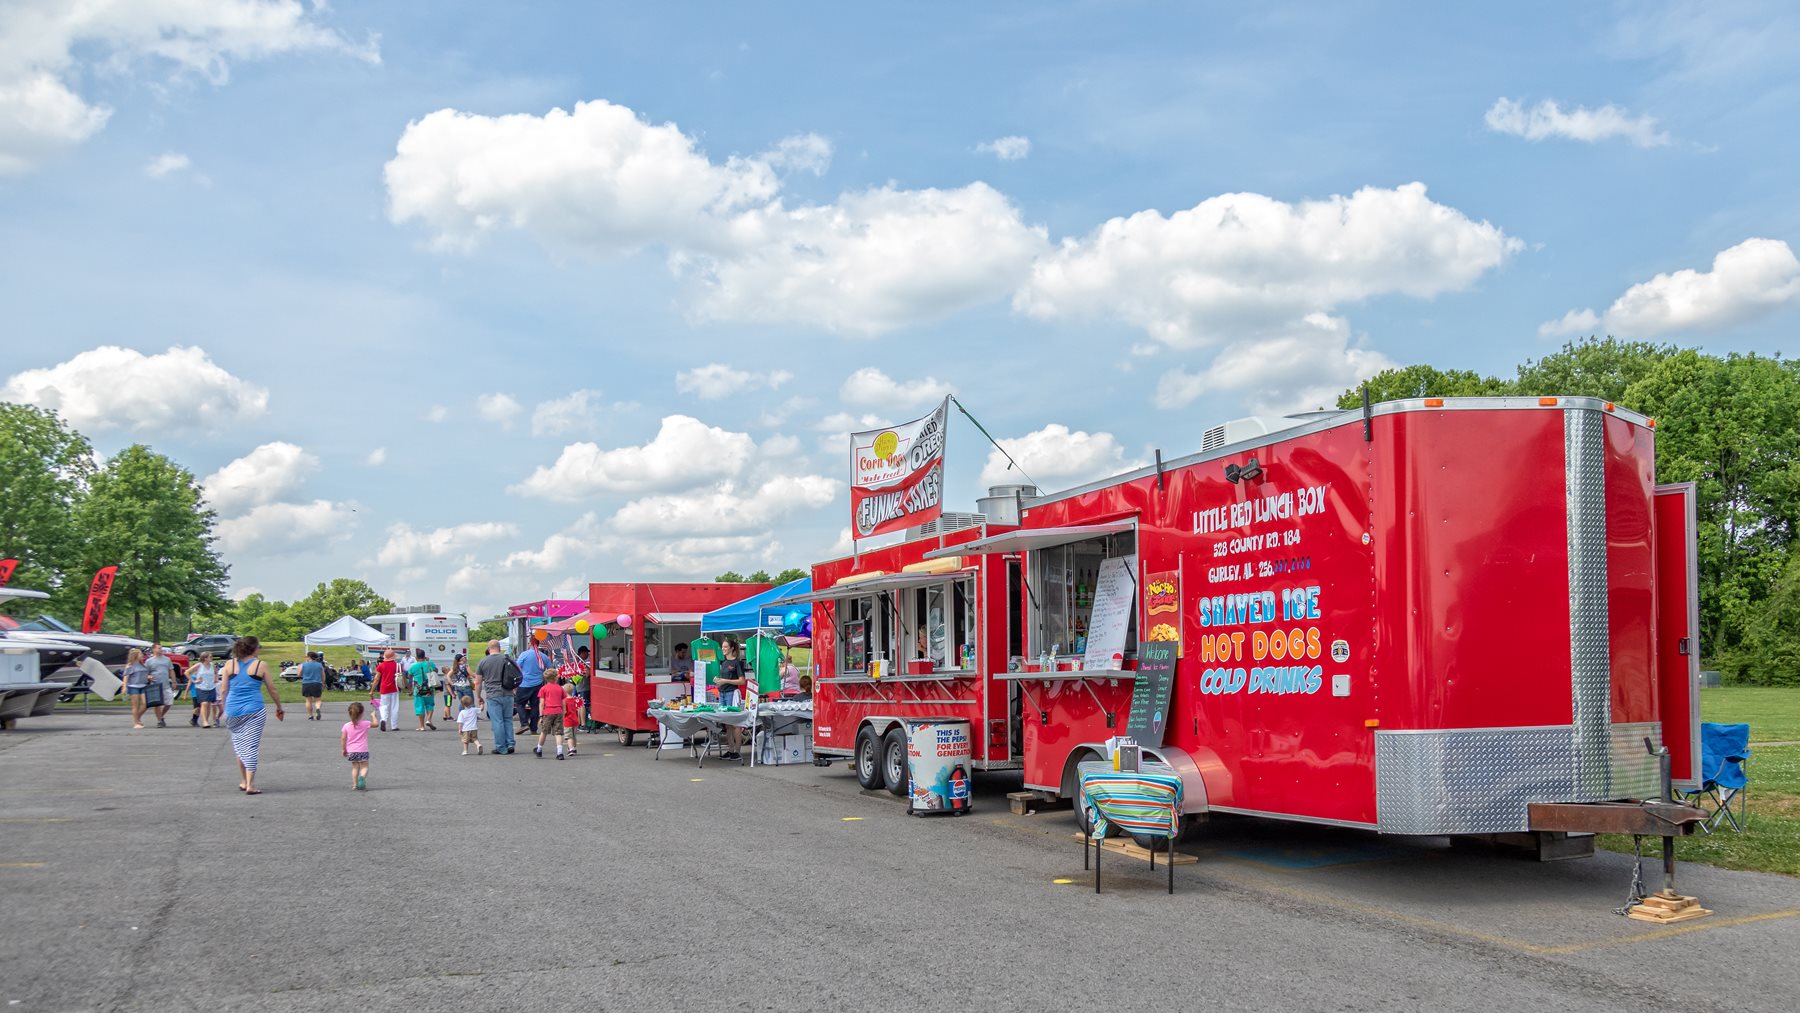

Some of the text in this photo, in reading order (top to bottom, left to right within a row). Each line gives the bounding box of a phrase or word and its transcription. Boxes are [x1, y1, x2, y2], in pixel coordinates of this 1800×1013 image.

[860, 456, 883, 471] Corn
[861, 472, 940, 527] FUNNEL CAKES
[1193, 486, 1327, 535] LITTLE RED LUNCH BOX
[1229, 537, 1264, 555] COUNTY
[1266, 533, 1281, 549] RD.
[1283, 529, 1301, 546] 184
[1208, 564, 1242, 584] GURLEY,
[1243, 562, 1254, 581] AL
[1199, 585, 1321, 627] SHAVED ICE
[1201, 632, 1245, 663] HOT
[1252, 626, 1322, 661] DOGS
[1200, 665, 1322, 696] COLD DRINKS
[936, 728, 960, 737] THIS IS
